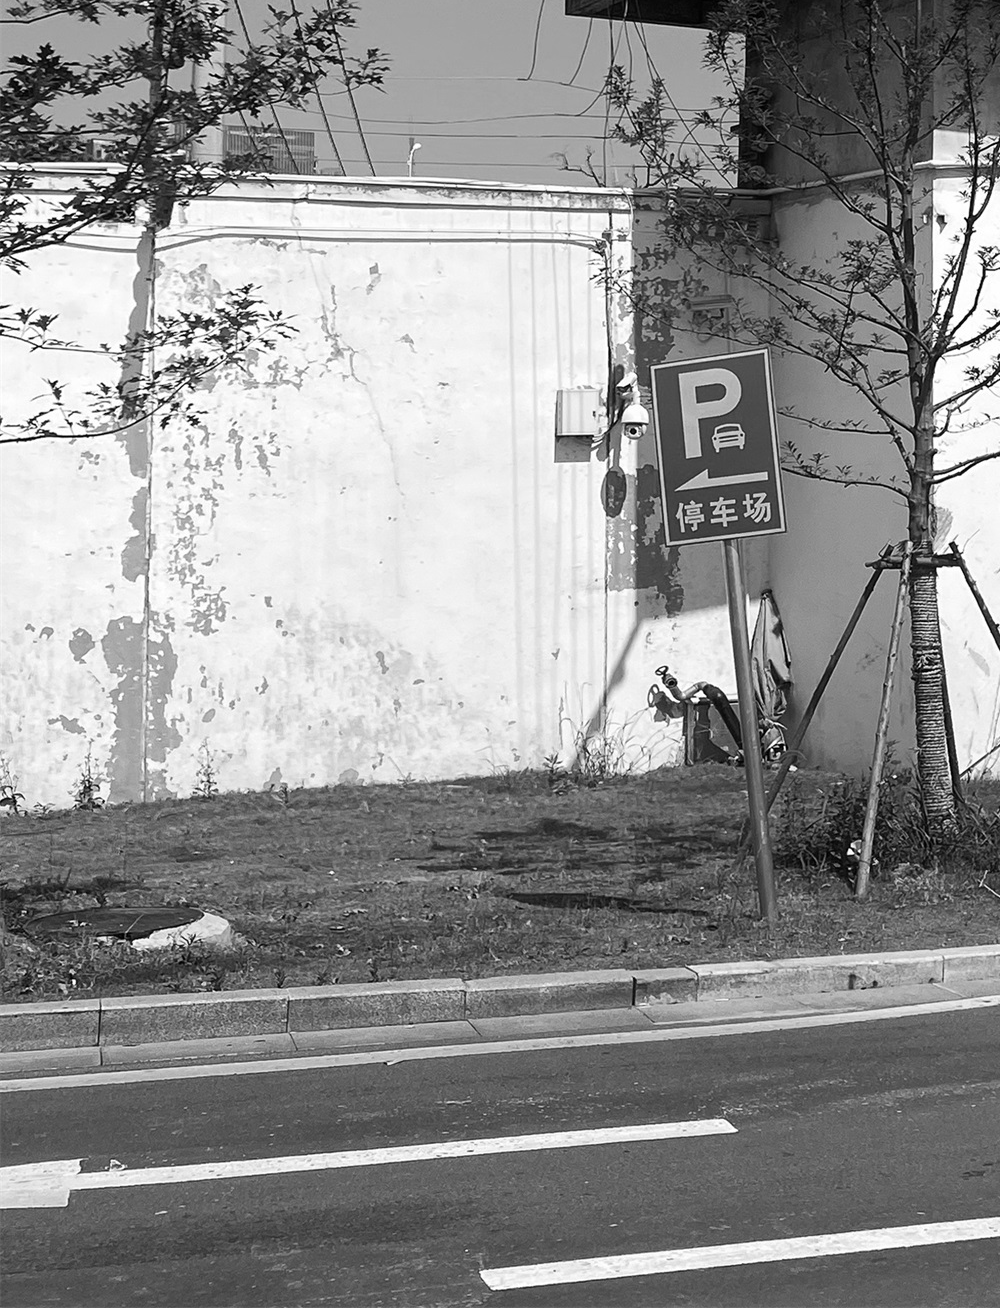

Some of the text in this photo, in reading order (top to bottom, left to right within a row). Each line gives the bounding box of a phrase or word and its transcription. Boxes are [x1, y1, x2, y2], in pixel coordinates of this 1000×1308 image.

[678, 367, 742, 459] P
[675, 492, 772, 533] 停车场
